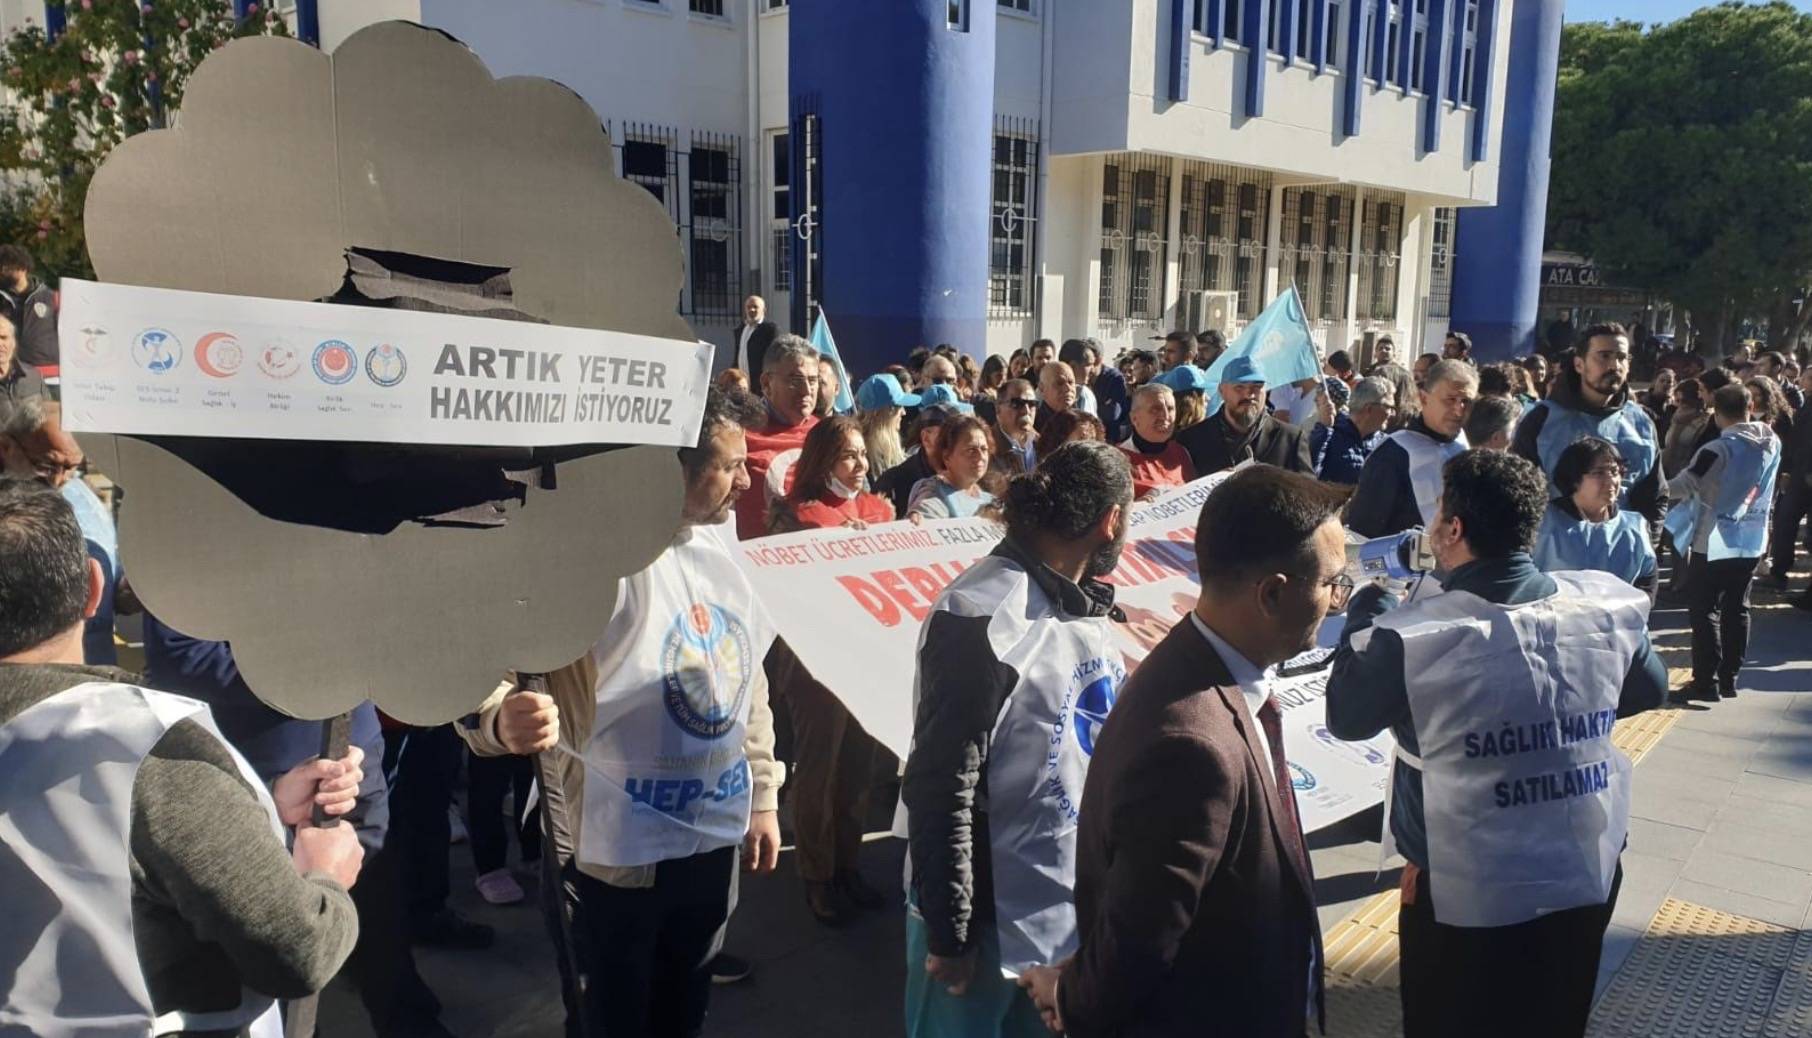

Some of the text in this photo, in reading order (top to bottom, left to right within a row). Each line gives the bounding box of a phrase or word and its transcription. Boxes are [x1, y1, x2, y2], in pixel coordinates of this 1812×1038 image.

[1549, 268, 1574, 284] ATA
[433, 343, 668, 389] ARTIK YETER
[430, 386, 673, 425] HAKKIMIZI İSTİYORUZ
[744, 542, 815, 568] NÖBET
[936, 526, 989, 545] FAZLA
[1465, 721, 1557, 759] SAĞLIK
[1049, 775, 1079, 826] AĞLIK
